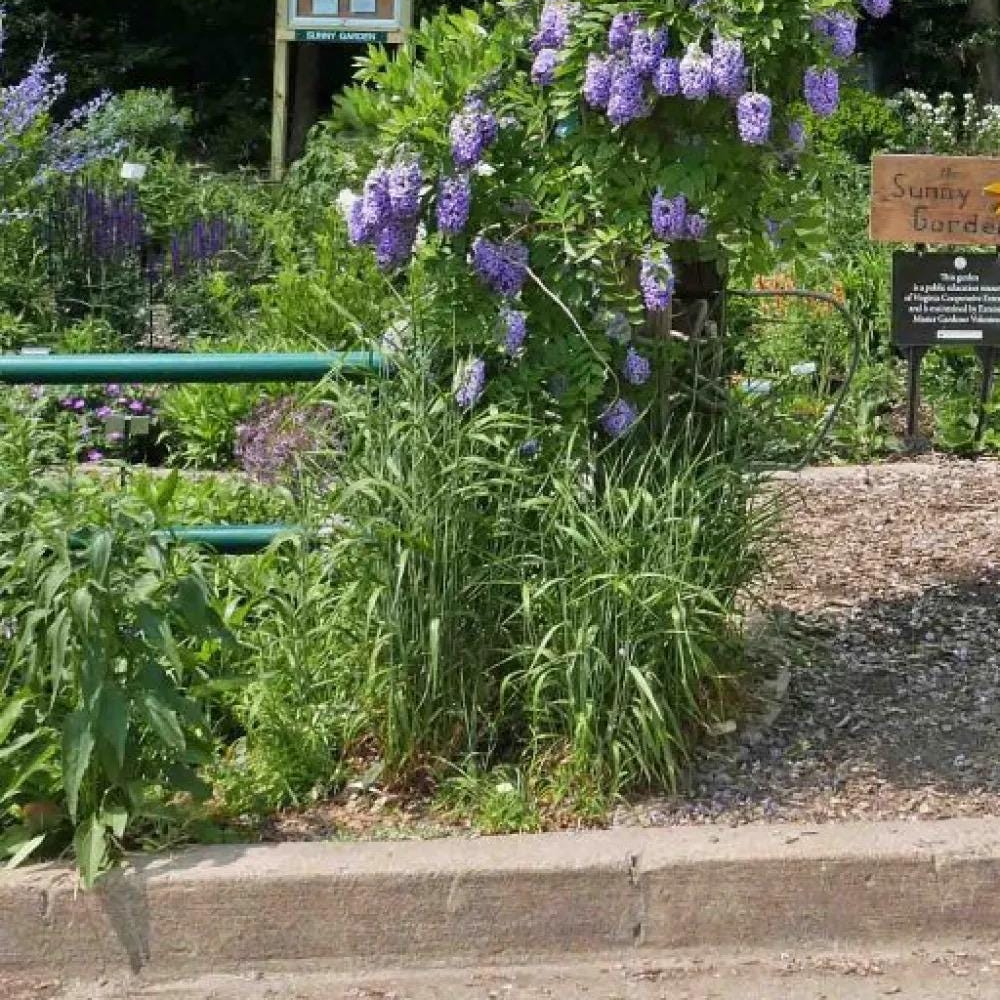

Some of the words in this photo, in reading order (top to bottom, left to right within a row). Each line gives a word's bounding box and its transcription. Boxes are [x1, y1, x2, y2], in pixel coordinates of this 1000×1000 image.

[306, 31, 335, 40] SUNNY
[339, 32, 375, 40] GARDEN
[892, 173, 969, 209] Sunny
[956, 273, 979, 284] garden
[925, 283, 946, 293] public
[947, 283, 979, 292] education
[914, 293, 940, 303] Virginia
